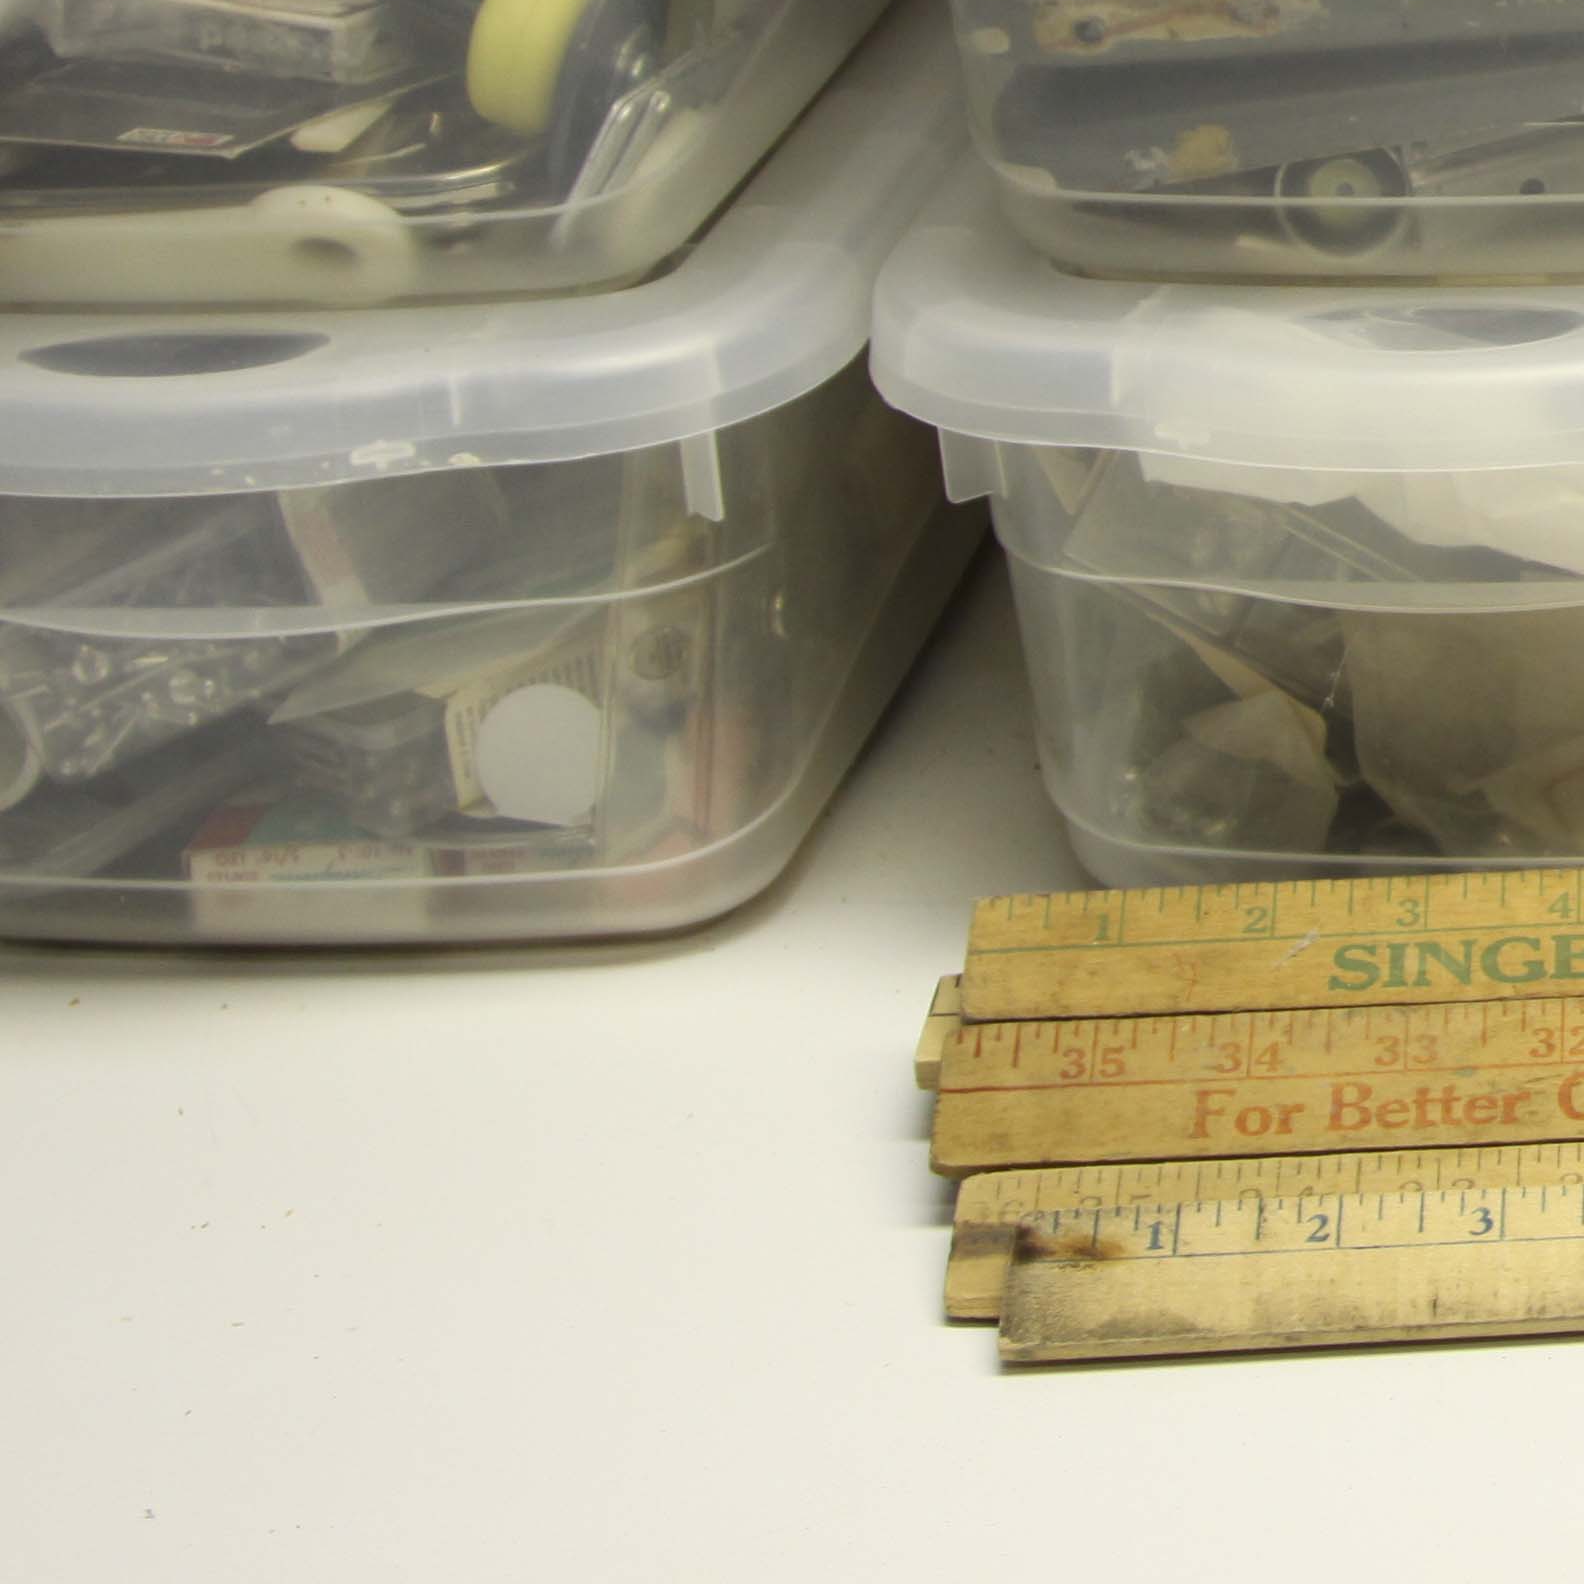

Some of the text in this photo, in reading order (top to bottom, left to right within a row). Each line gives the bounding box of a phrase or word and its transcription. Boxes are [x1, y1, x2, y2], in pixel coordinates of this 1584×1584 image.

[1098, 915, 1114, 941] 1
[1242, 908, 1267, 934] 2
[1397, 899, 1420, 927] 3
[1547, 892, 1572, 919] 4
[1060, 1047, 1127, 1079] 35
[1215, 1041, 1285, 1073] 34
[1374, 1035, 1439, 1066] 33
[1188, 1090, 1304, 1138] For
[1326, 1080, 1532, 1133] Better
[1147, 1223, 1164, 1250] 1
[1307, 1214, 1331, 1243] 2
[1469, 1208, 1494, 1235] 3
